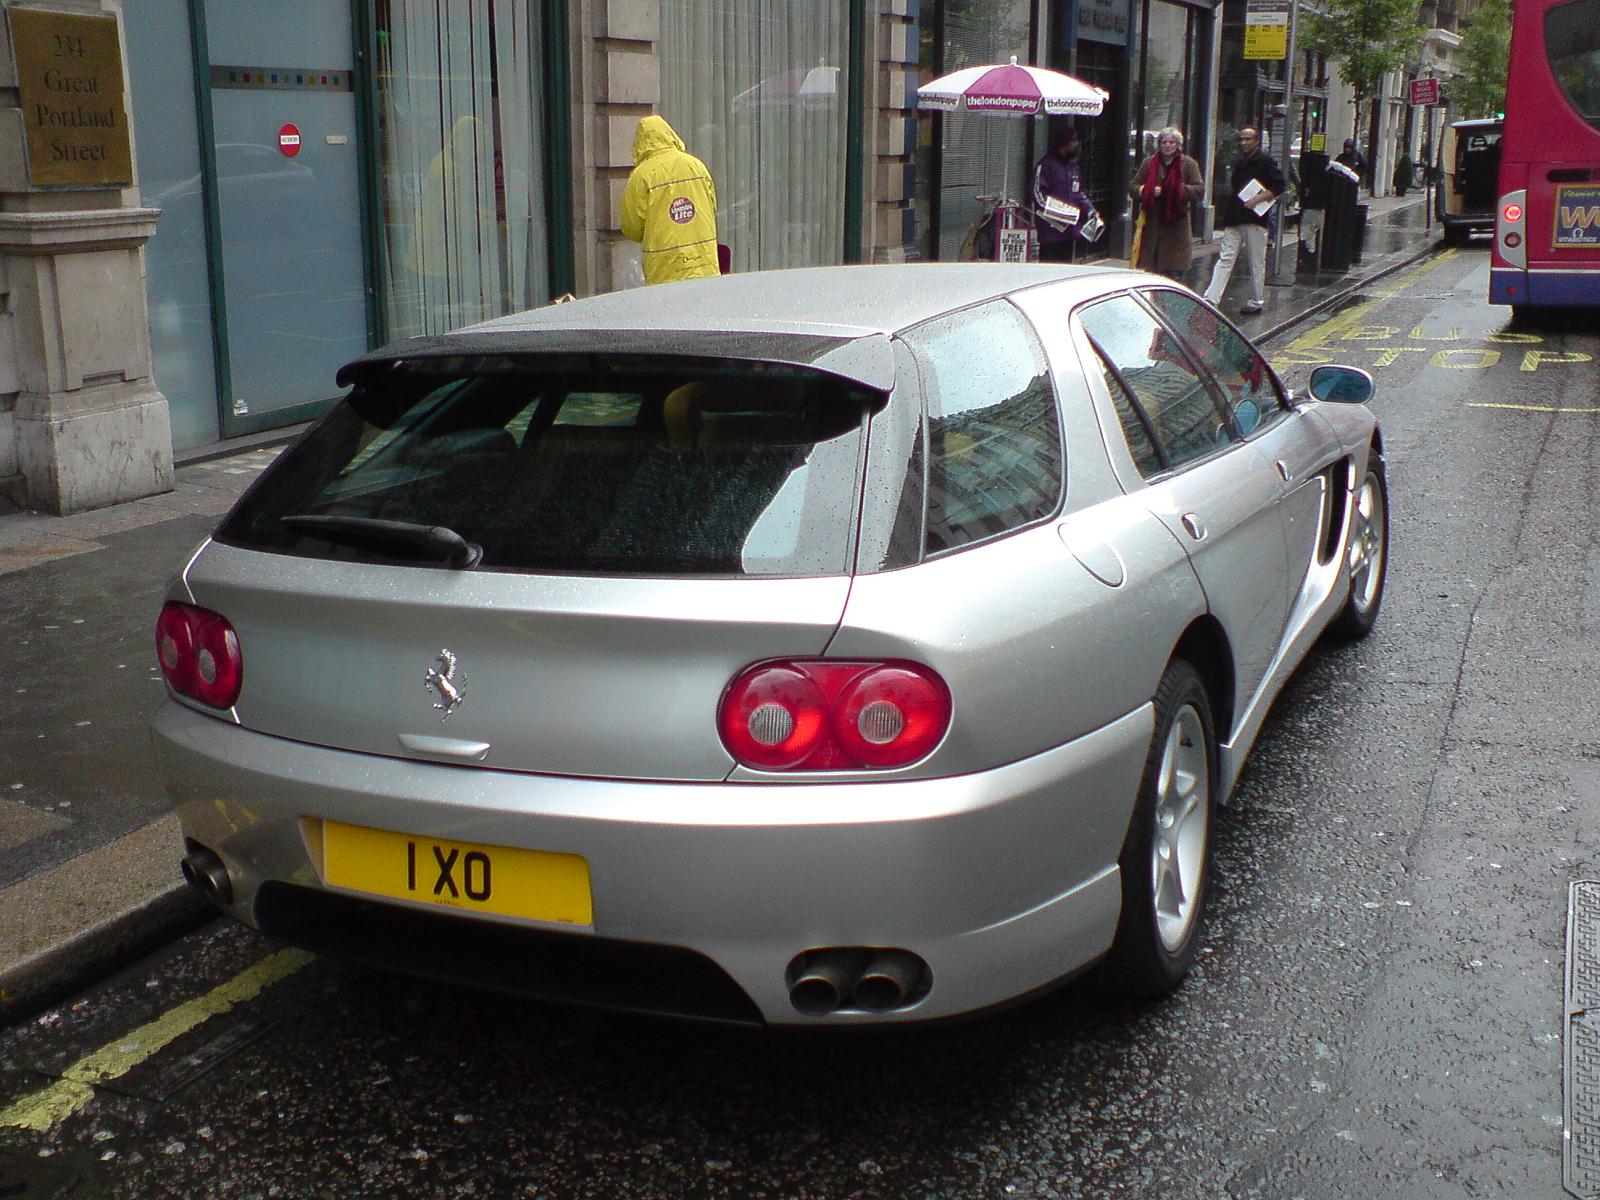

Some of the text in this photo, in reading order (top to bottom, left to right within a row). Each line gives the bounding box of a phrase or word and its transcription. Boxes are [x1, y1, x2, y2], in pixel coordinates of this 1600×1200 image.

[54, 34, 85, 58] 234
[44, 70, 99, 95] Great
[967, 96, 1038, 109] thelondonpaper
[1047, 98, 1100, 111] thelondonpaper
[35, 103, 116, 128] Portland
[52, 138, 107, 161] Street
[674, 210, 693, 220] Lite
[1003, 244, 1024, 252] FREE
[1341, 325, 1545, 343] BUS
[1270, 347, 1593, 373] STOP
